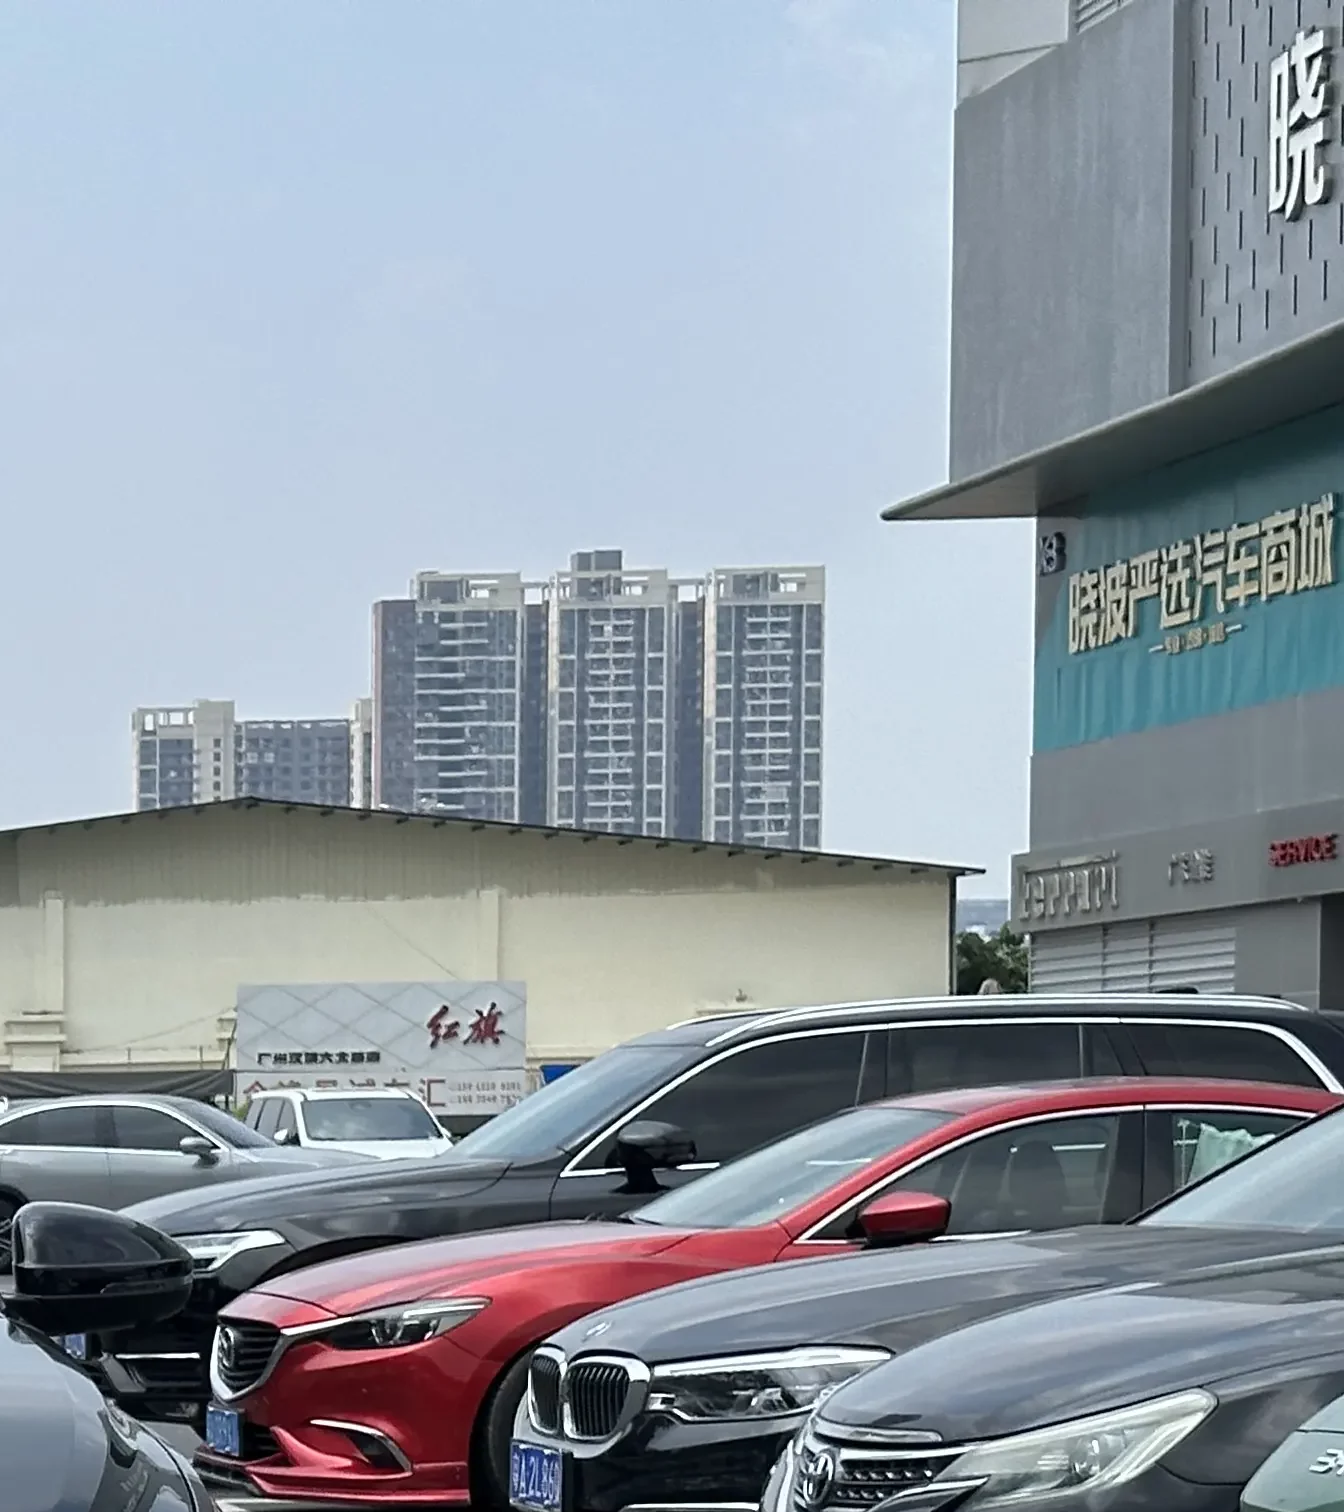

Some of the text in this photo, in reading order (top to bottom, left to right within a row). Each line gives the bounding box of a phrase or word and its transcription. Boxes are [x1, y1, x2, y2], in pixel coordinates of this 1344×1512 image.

[1269, 30, 1326, 221] 晓
[1068, 492, 1334, 655] 晓波严选汽车商城
[426, 1002, 506, 1049] 红旗
